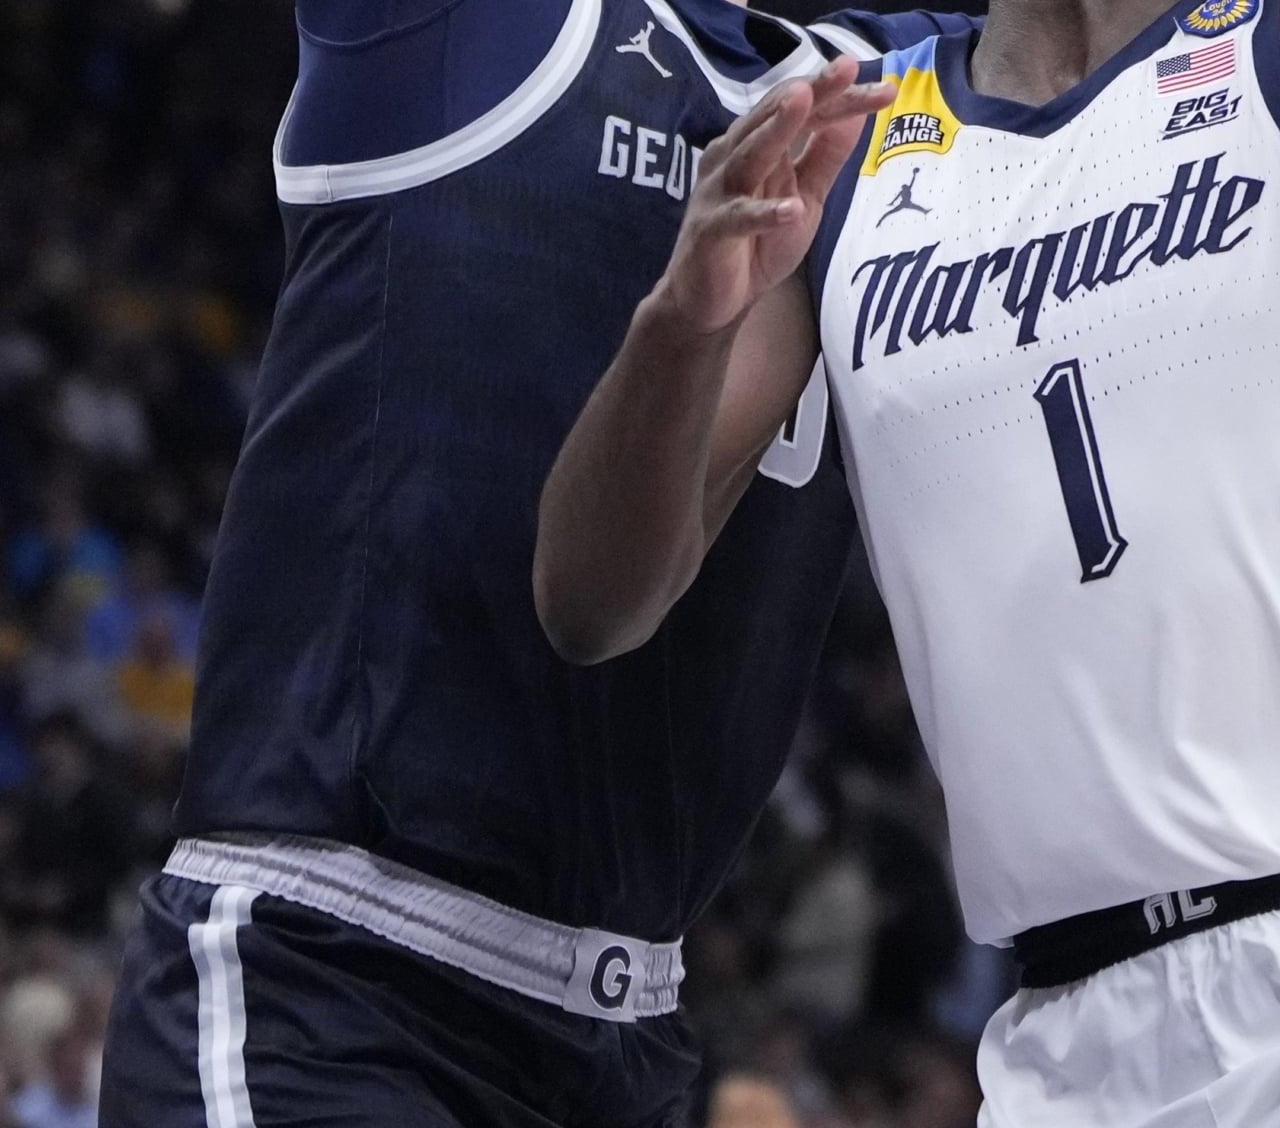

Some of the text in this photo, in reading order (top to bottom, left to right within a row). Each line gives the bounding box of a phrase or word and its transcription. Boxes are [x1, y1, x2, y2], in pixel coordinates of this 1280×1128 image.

[1164, 95, 1243, 132] EAST
[1172, 87, 1230, 116] BIG
[881, 128, 944, 151] HANGE
[902, 114, 939, 130] THE
[850, 152, 1266, 372] Marquette
[1033, 358, 1129, 584] 1
[588, 943, 634, 1012] G
